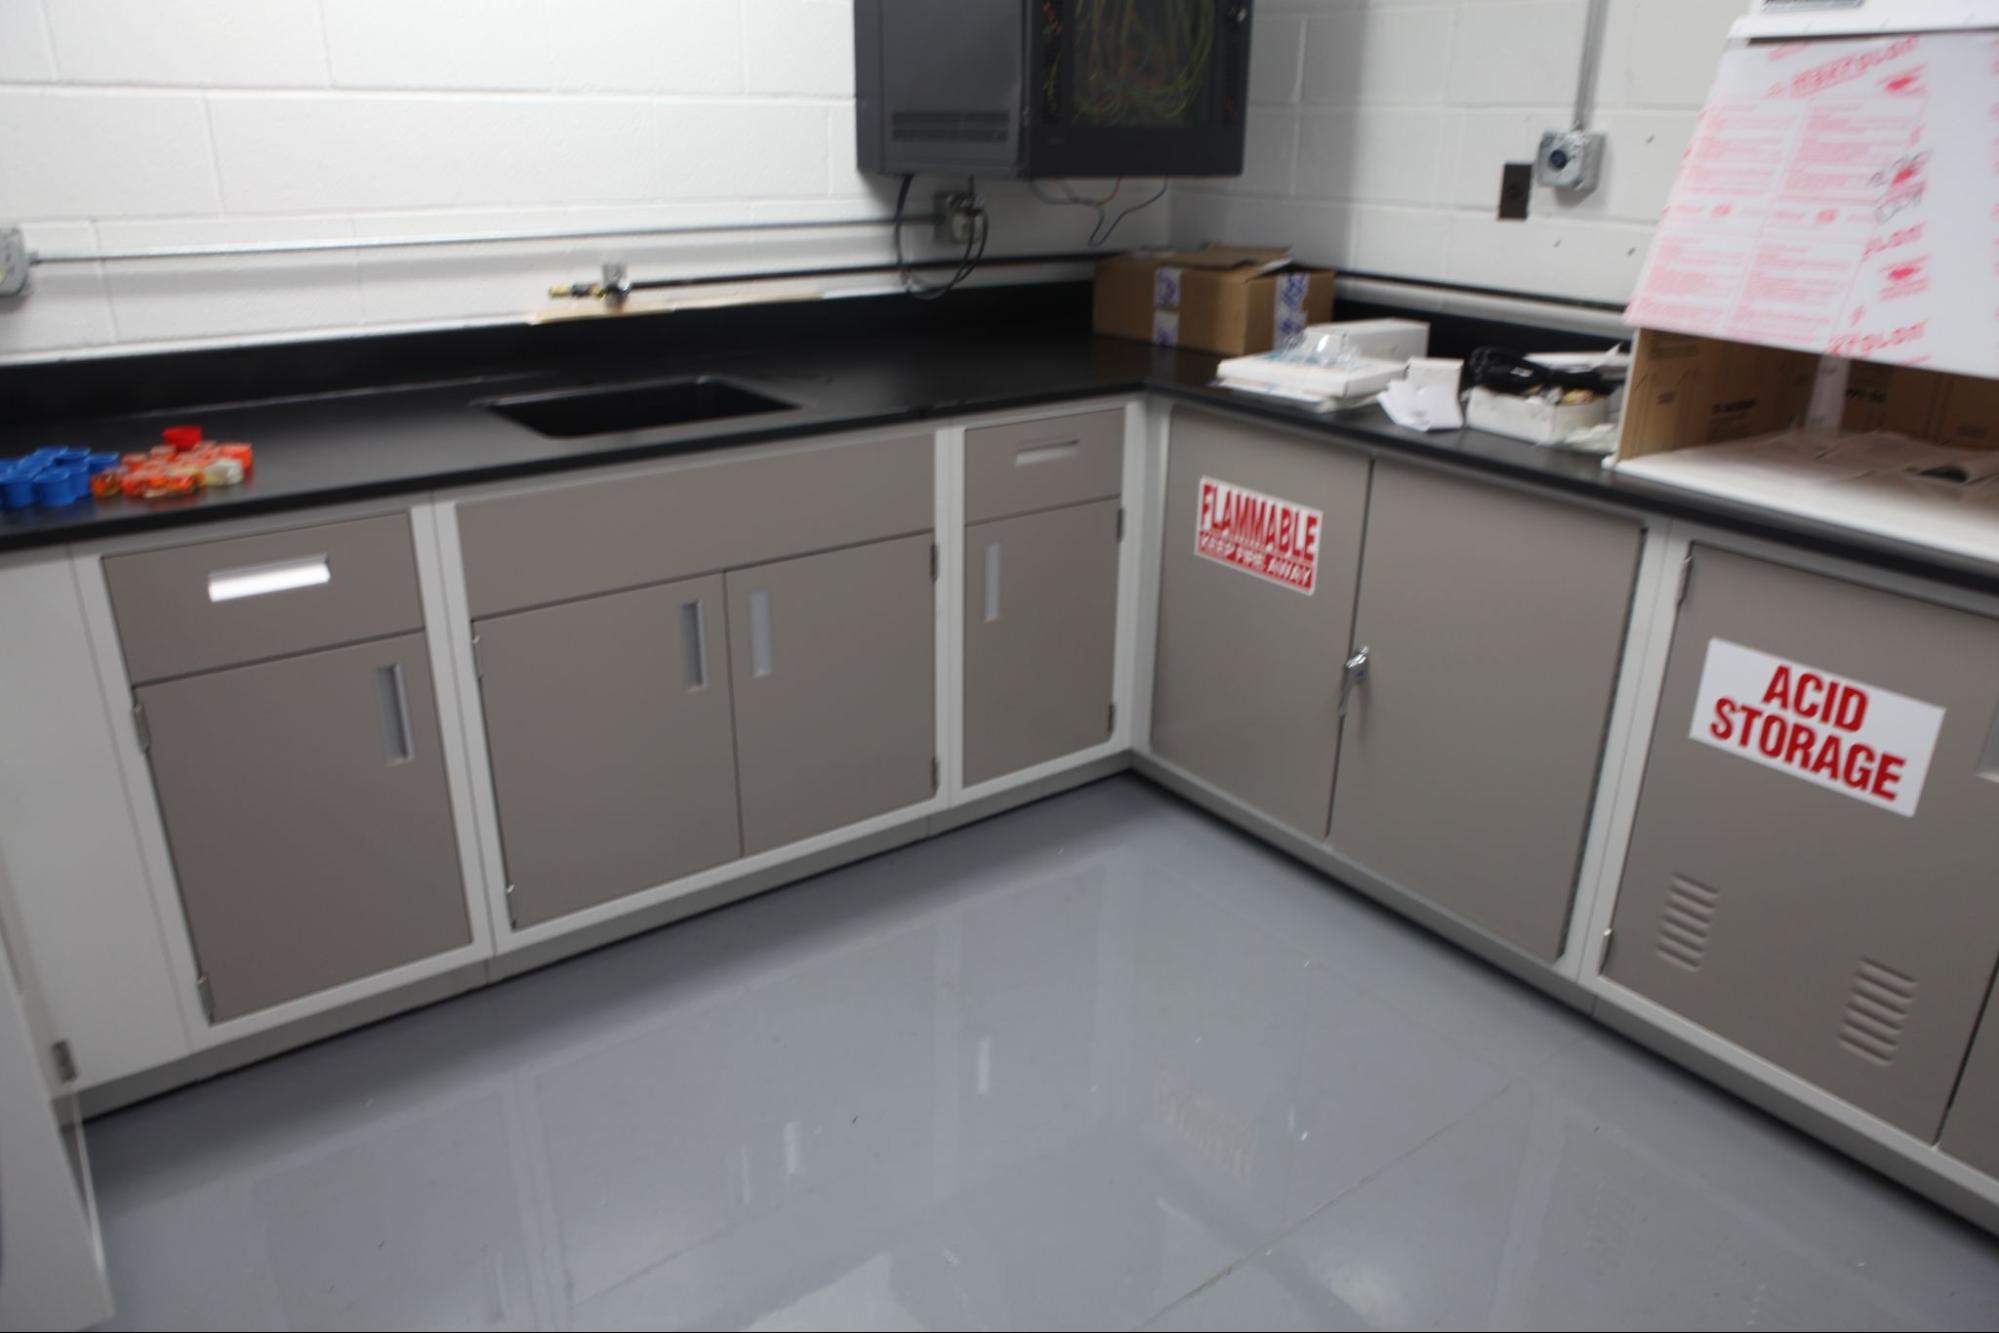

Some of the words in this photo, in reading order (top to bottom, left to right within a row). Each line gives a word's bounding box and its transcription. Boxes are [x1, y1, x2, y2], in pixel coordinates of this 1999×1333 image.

[1201, 484, 1318, 562] FLAMMABLE
[1762, 664, 1867, 733] ACID
[1709, 697, 1906, 801] STORAGE
